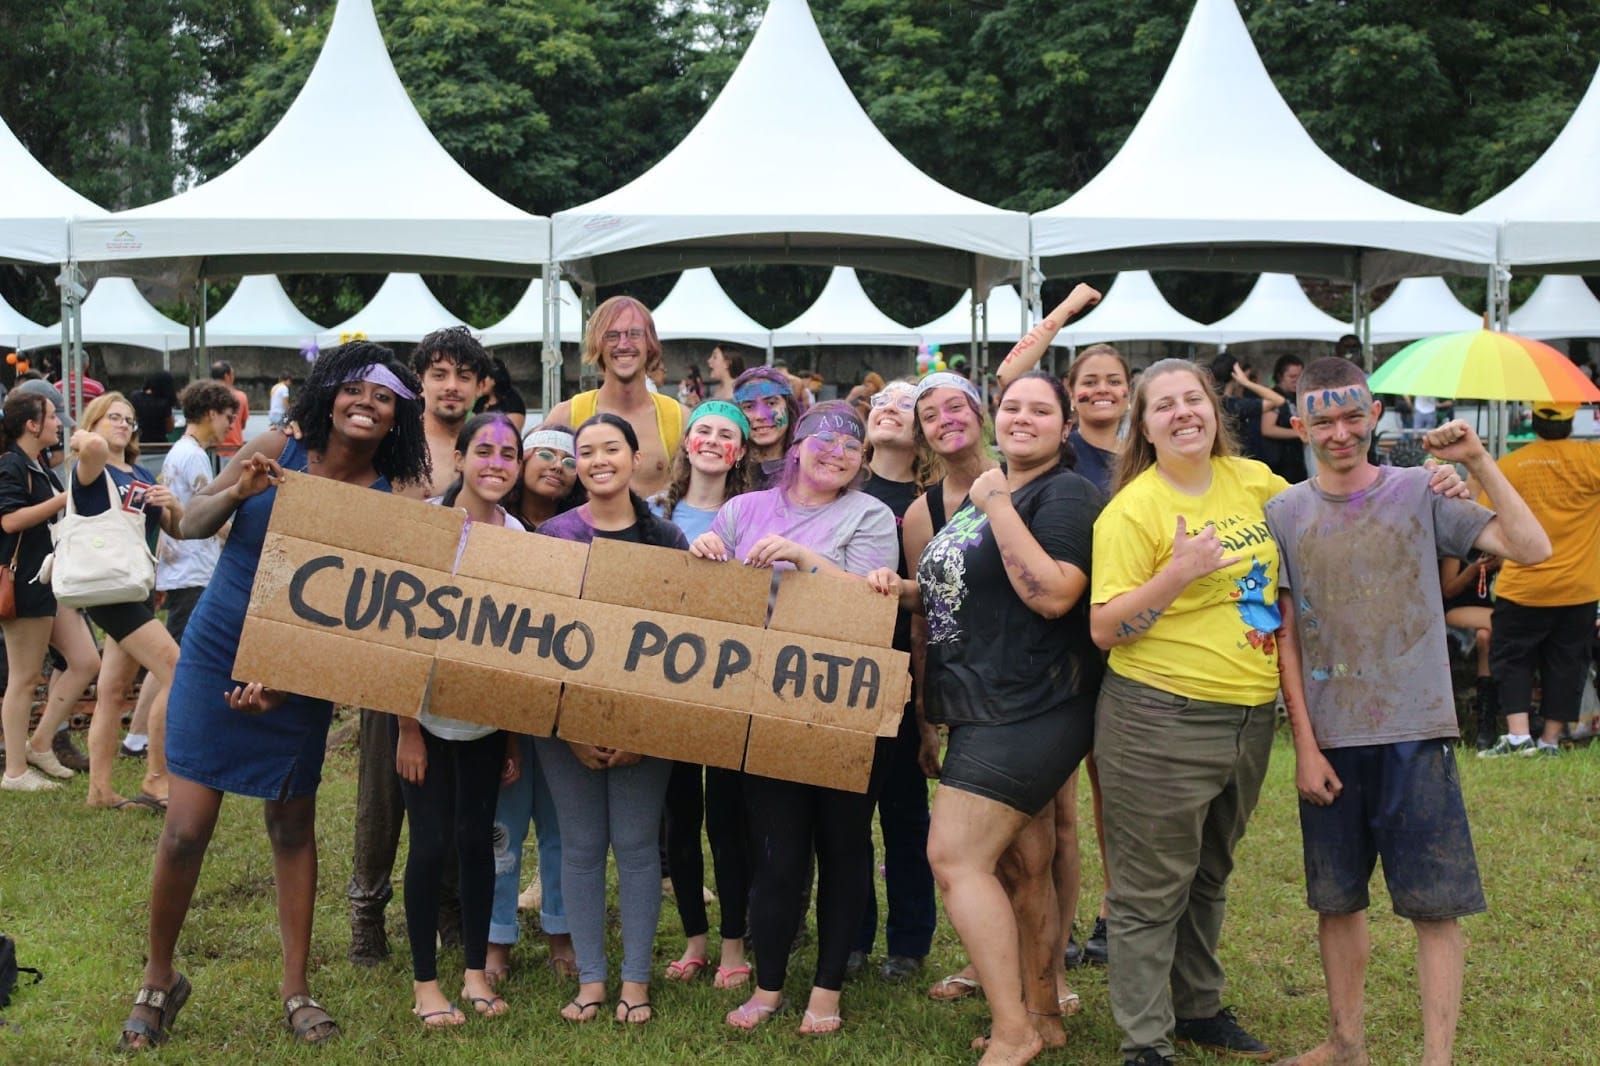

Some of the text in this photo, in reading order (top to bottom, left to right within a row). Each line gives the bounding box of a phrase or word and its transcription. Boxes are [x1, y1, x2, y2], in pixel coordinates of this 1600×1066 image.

[288, 555, 881, 711] CURSINHO POP AJA
